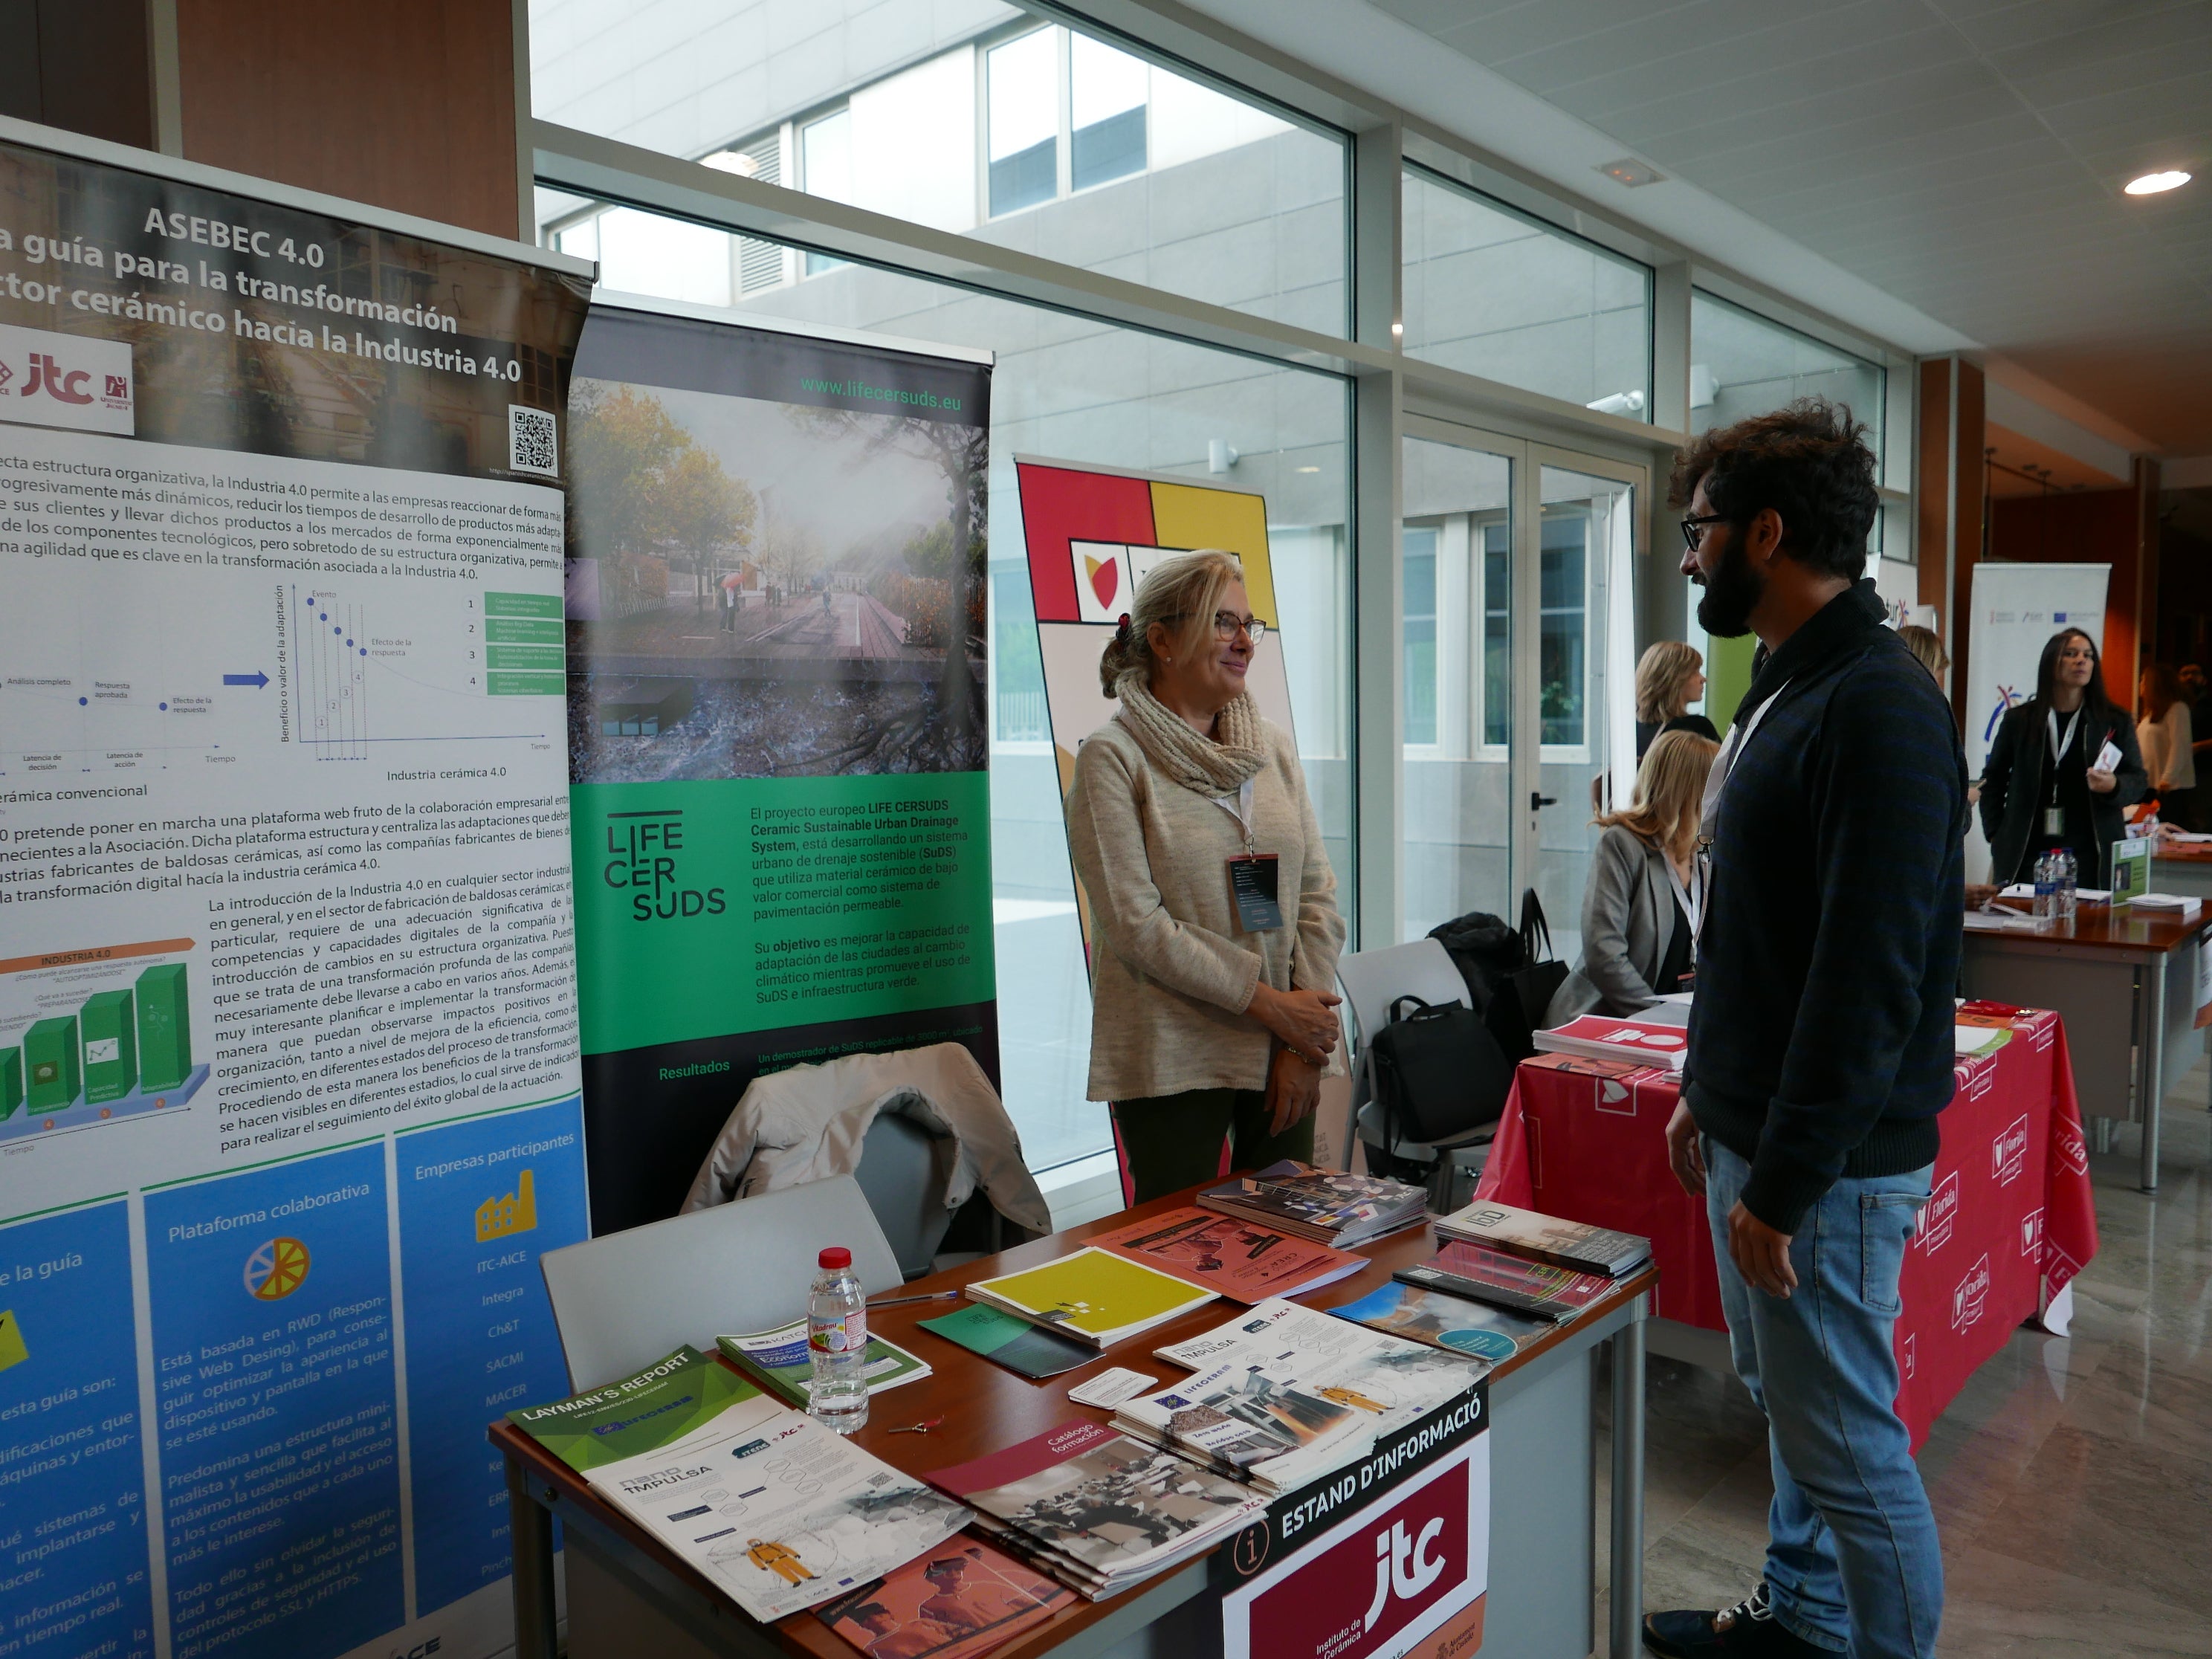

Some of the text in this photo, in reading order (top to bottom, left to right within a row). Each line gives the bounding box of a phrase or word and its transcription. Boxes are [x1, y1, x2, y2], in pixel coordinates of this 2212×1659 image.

[143, 207, 324, 268] ASEBEC 4.0
[23, 234, 456, 334] guía para la transformación
[70, 289, 225, 332] cerámico
[322, 325, 347, 354] la
[355, 332, 476, 375] Industria
[482, 356, 520, 382] 4.0
[801, 378, 961, 411] www.lifecersuds.eu
[23, 541, 478, 579] agilidad que es clave en la transformación asociada a la Industria 4.0.
[276, 585, 286, 638] adaptación
[468, 600, 473, 608] 1
[469, 625, 475, 633] 2
[277, 640, 285, 649] la
[277, 650, 286, 663] de
[470, 651, 476, 659] 3
[278, 665, 288, 689] valor
[470, 677, 476, 686] 4
[279, 699, 289, 743] Beneficio
[204, 755, 236, 763] Tiempo
[387, 766, 506, 780] Industria cerámica 4.0
[56, 783, 147, 800] convencional
[13, 795, 553, 844] pretende poner en marcha una plataforma web fruto de la colaboración empresarial
[751, 799, 948, 821] El proyecto europeo LIFE CERSUDS
[751, 815, 959, 836] Ceramic Sustainable Urban Drainage
[607, 822, 683, 862] LIFE
[604, 857, 676, 894] CER
[633, 887, 726, 922] SUDS
[754, 896, 904, 922] pavimentación permeable.
[754, 923, 969, 954] Su objetivo es mejorar la capacidad de
[41, 949, 110, 966] INDUSTRIA 4.0
[756, 974, 919, 1003] SuDS e infraestructura verde.
[659, 1060, 730, 1080] Resultados
[220, 1071, 562, 1154] para realizar el seguimiento del éxito global de la actuación.
[415, 1133, 574, 1180] Empresas participantes
[168, 1183, 369, 1243] Plataforma colaborativa
[16, 1252, 82, 1281] la guía
[477, 1249, 526, 1273] ITC-AICE
[482, 1287, 523, 1306] Integra
[161, 1296, 386, 1371] Está basada en RWD (Respon-
[488, 1319, 519, 1337] Ch&T
[486, 1351, 523, 1373] SACMI
[621, 1352, 691, 1392] REPORT
[0, 1377, 115, 1420] esta guía son:
[485, 1383, 526, 1407] MACER
[1047, 1424, 1093, 1446] Catálogo
[1051, 1429, 1105, 1454] formación
[1281, 1475, 1356, 1539] ESTAND
[1360, 1391, 1482, 1490] D'INFORMACIÓ
[1316, 1618, 1361, 1655] Instituto de
[1323, 1632, 1361, 1659] Cerámica
